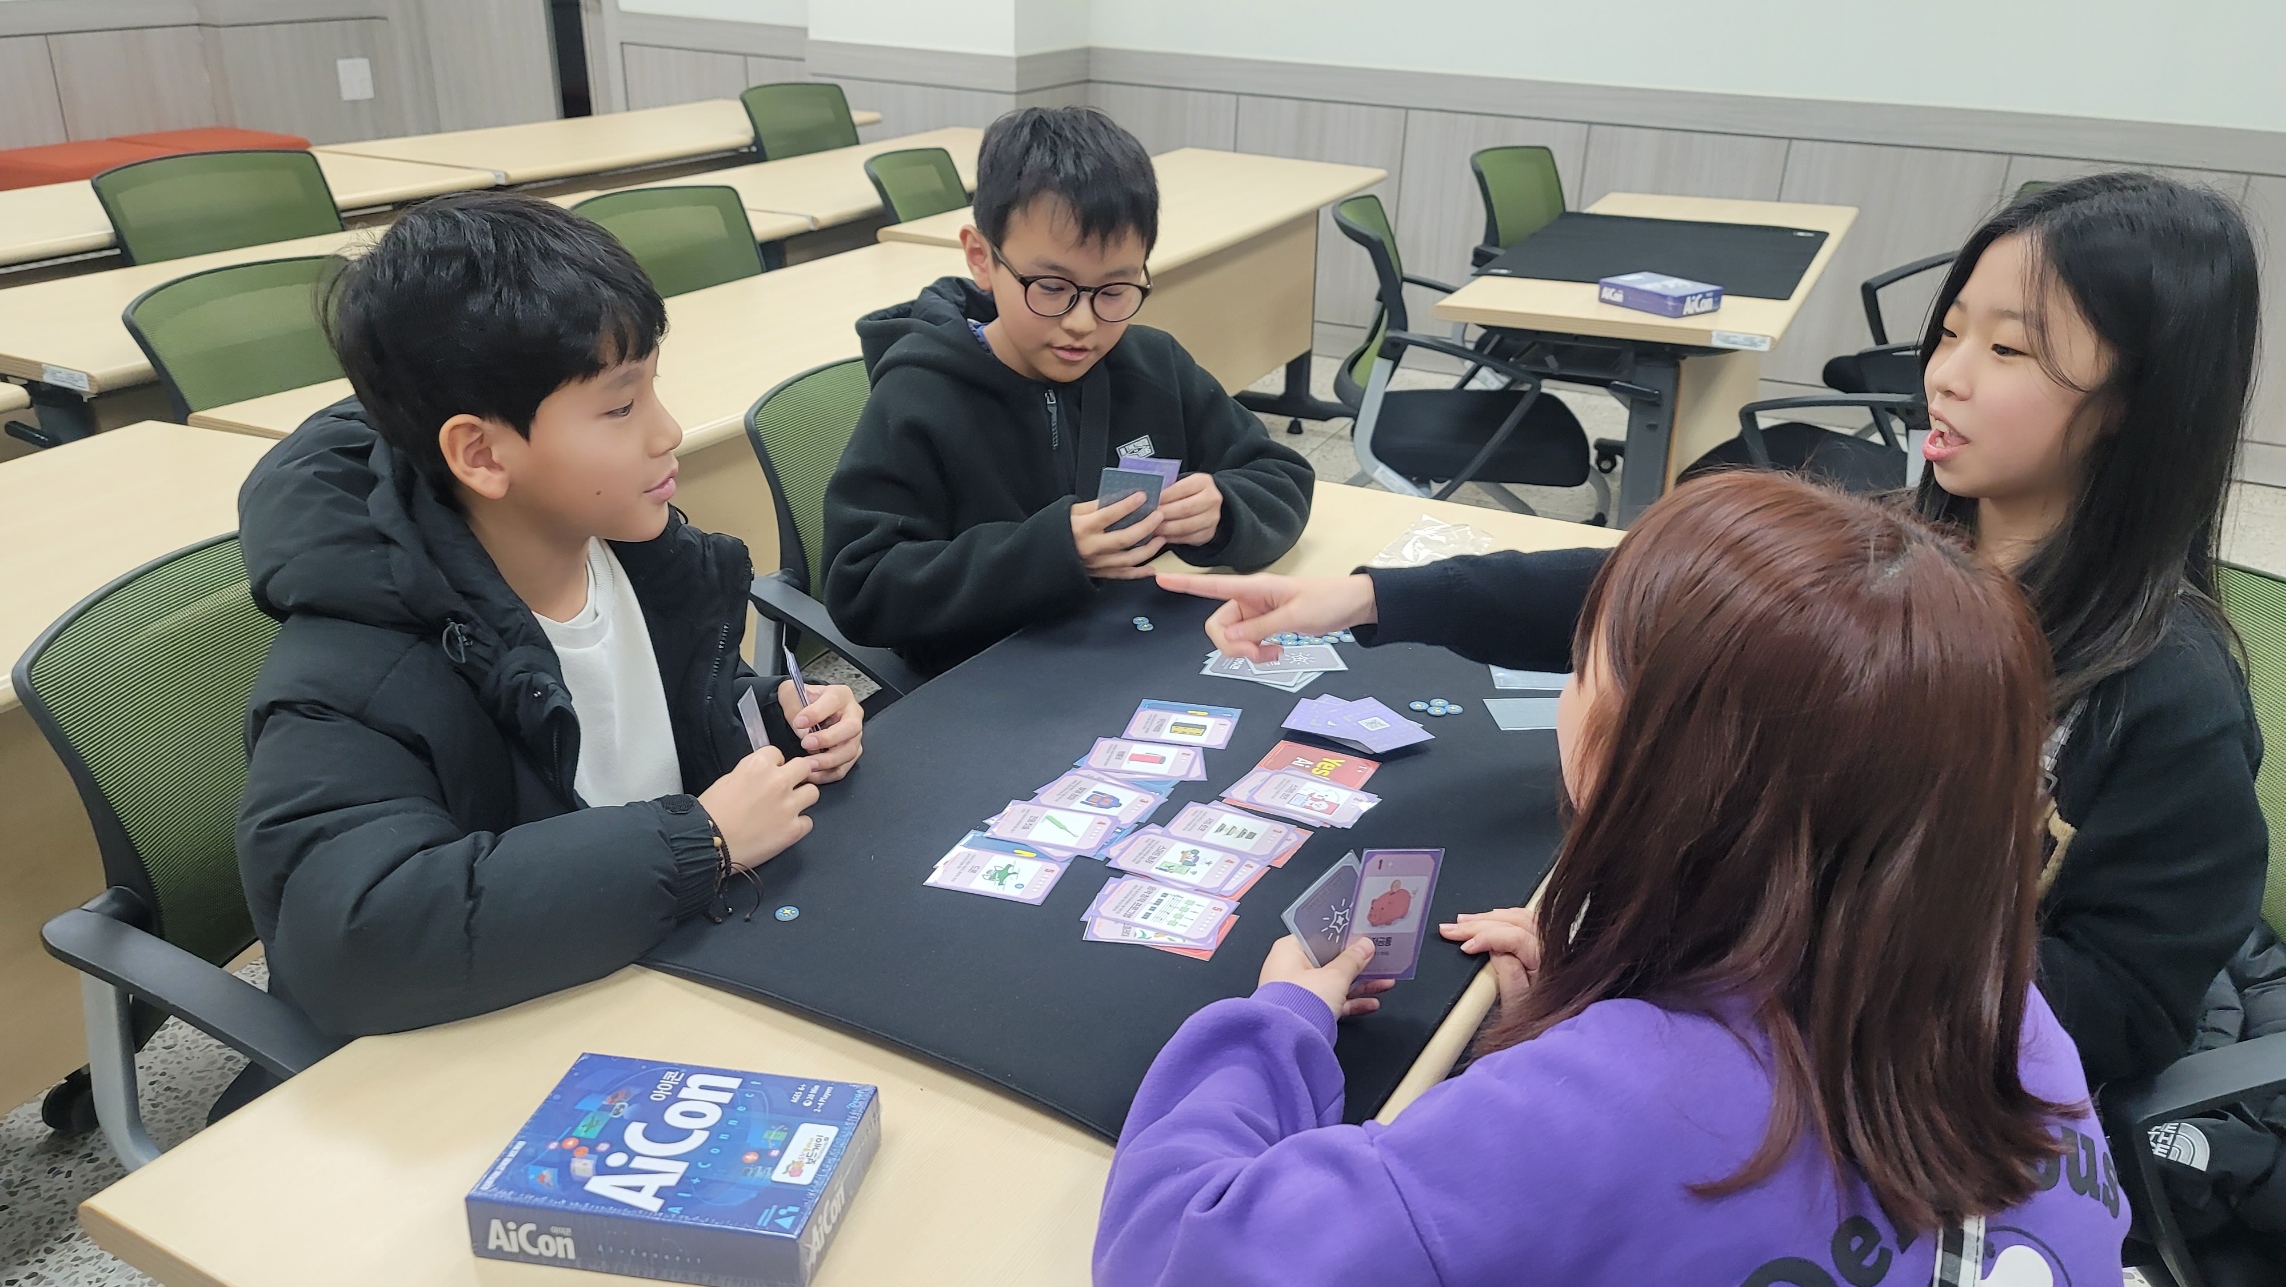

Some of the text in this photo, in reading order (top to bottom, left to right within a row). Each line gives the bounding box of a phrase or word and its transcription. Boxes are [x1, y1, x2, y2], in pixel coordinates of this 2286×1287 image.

[1601, 287, 1624, 302] AiCon
[1682, 294, 1713, 316] AiCon
[1292, 756, 1314, 768] Ai
[1152, 845, 1166, 857] 스마트
[1378, 859, 1383, 870] 1
[1140, 892, 1150, 902] 창작
[1147, 886, 1157, 894] 음악
[1122, 901, 1142, 918] 프로그램
[650, 1070, 685, 1102] 아이콘
[790, 1090, 802, 1103] AGES
[818, 1086, 834, 1102] Players
[583, 1073, 744, 1212] AiCon
[805, 1134, 830, 1165] 보드게임
[550, 1226, 572, 1236] 아이콘
[808, 1182, 846, 1265] AiCon
[488, 1219, 576, 1260] AiCon
